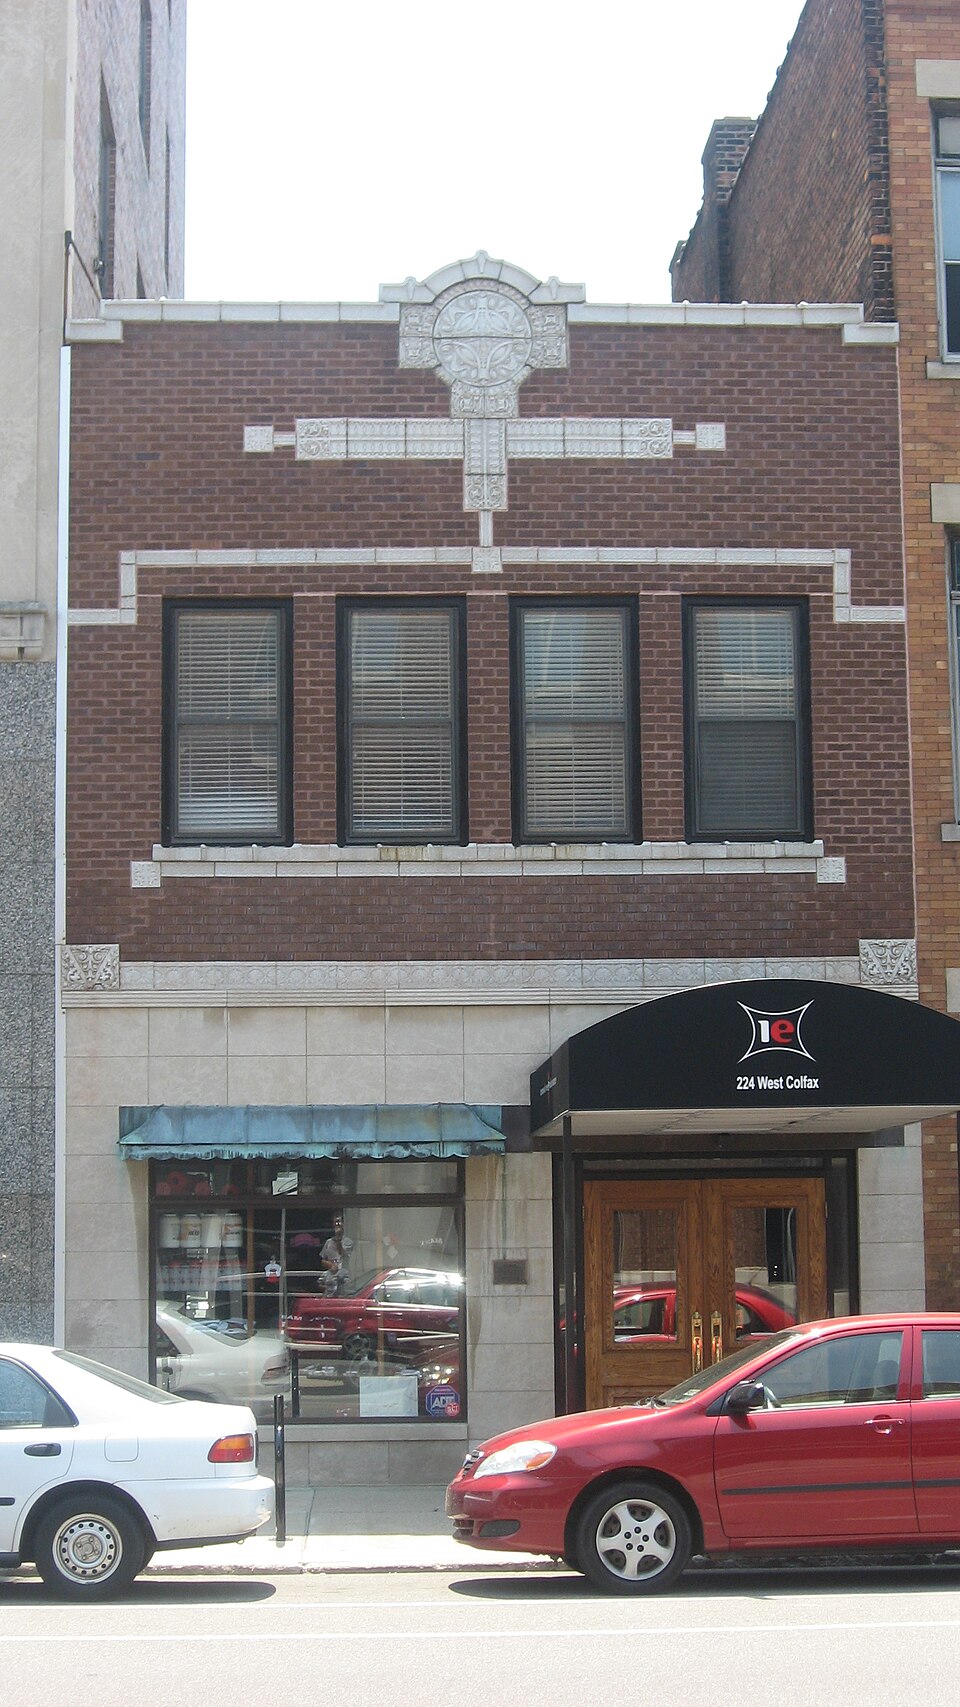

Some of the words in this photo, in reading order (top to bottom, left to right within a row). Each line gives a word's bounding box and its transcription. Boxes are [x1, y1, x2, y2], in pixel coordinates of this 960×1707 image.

[736, 1076, 755, 1090] 224
[757, 1075, 784, 1090] West
[786, 1075, 820, 1089] Colfax
